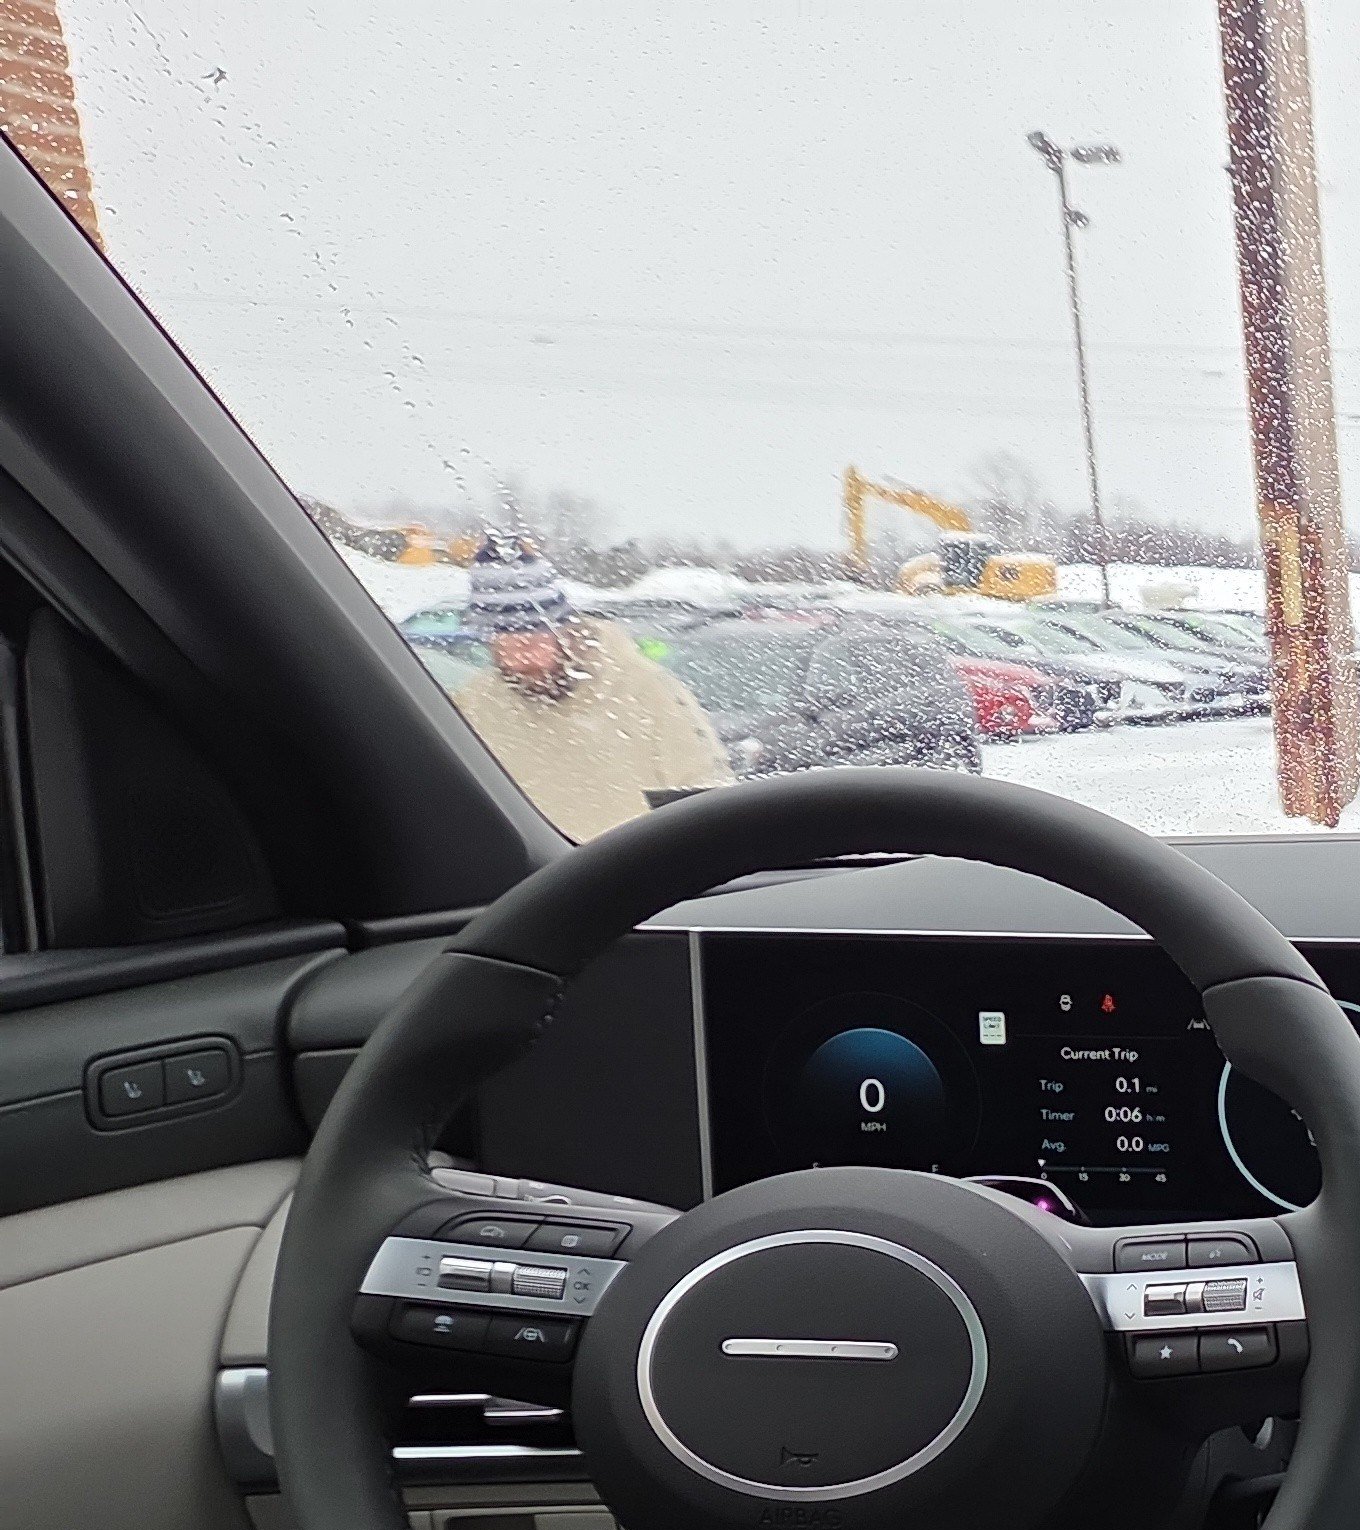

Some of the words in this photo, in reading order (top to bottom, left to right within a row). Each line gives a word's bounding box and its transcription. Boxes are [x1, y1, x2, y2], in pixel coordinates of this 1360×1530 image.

[1060, 1046, 1110, 1060] Current
[1112, 1047, 1139, 1063] Trip
[1039, 1079, 1064, 1093] Trip
[1115, 1076, 1140, 1093] 0.1
[859, 1078, 885, 1113] 0
[1039, 1108, 1075, 1121] Timer
[1104, 1106, 1143, 1122] 0:06
[861, 1121, 887, 1132] MPH
[1041, 1139, 1067, 1152] Avg.
[1116, 1136, 1144, 1152] 0.0
[1148, 1143, 1170, 1152] MPG
[1041, 1172, 1048, 1180] 0
[1079, 1172, 1089, 1182] 15
[1119, 1173, 1131, 1182] 30
[1155, 1173, 1168, 1183] 45
[757, 1507, 844, 1529] AIRBAG
